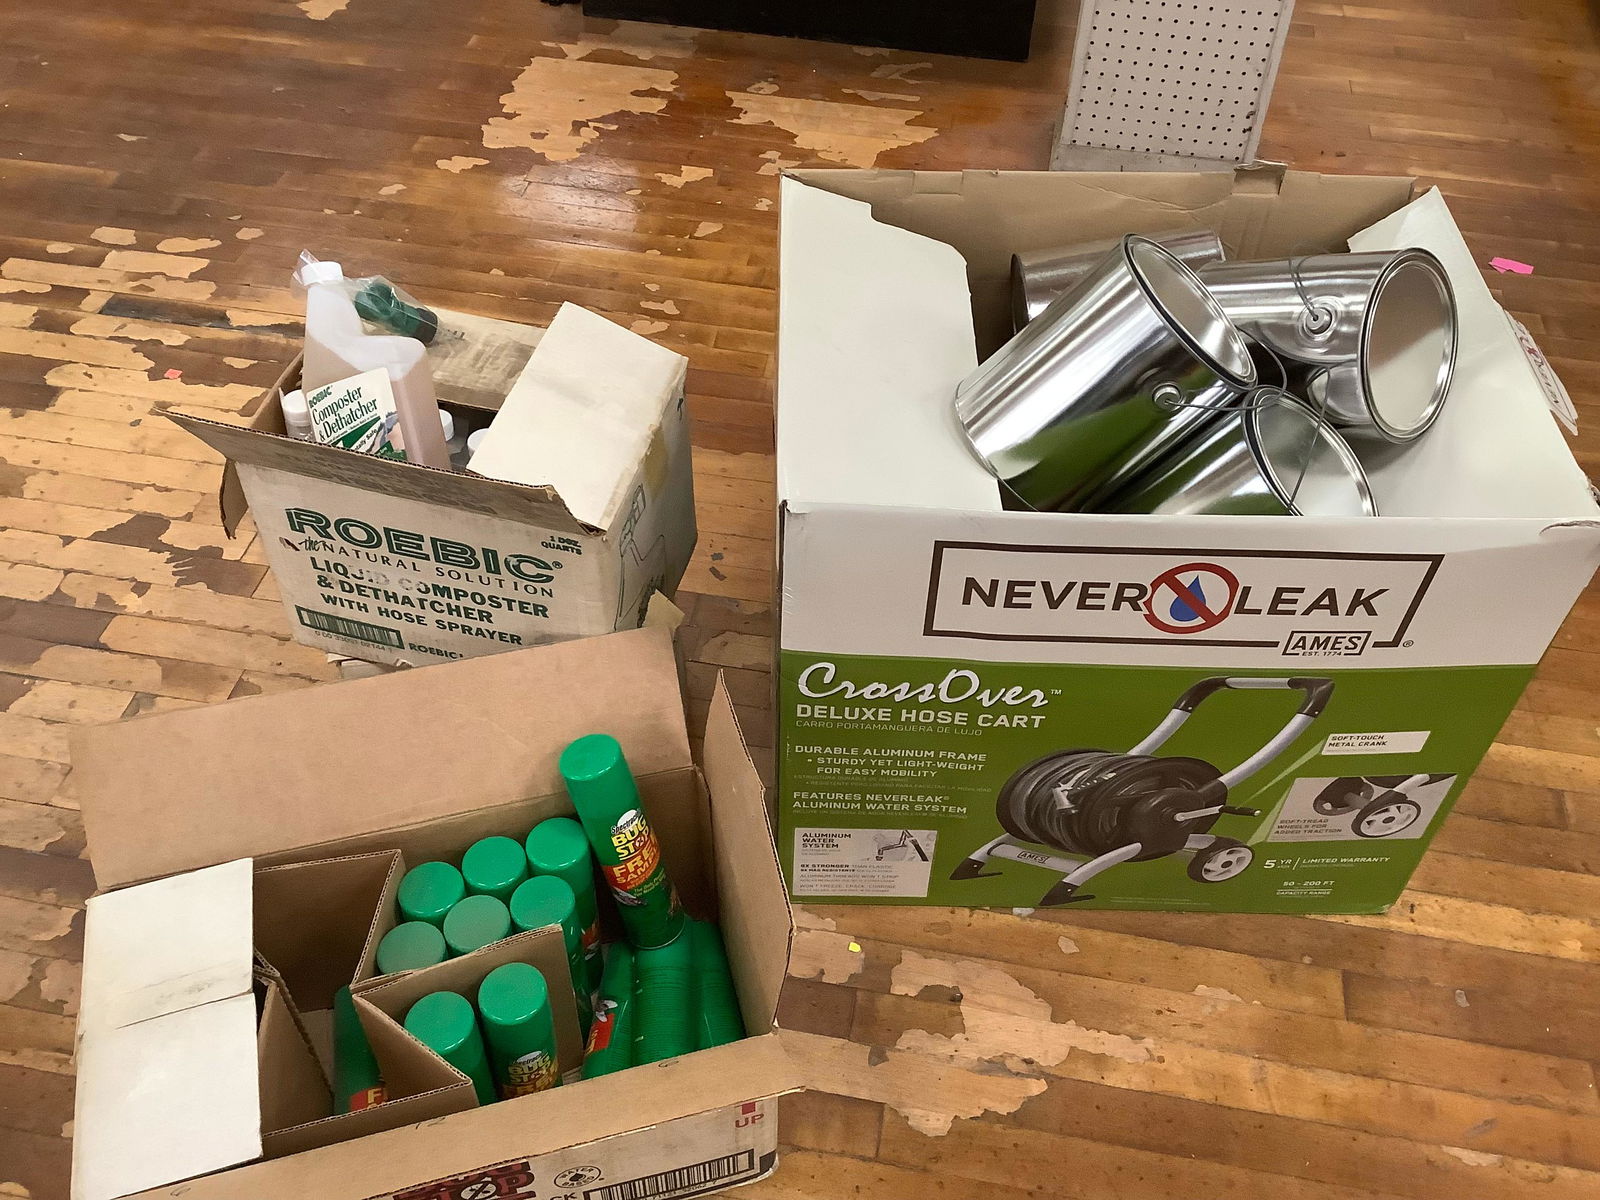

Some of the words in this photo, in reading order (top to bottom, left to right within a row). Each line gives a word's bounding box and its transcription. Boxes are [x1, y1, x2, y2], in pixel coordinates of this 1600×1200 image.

[312, 386, 363, 426] Composter
[319, 430, 325, 442] &
[323, 398, 378, 439] Dethatcher
[541, 541, 582, 555] QUARTS
[299, 535, 323, 552] the
[323, 543, 421, 572] NATURAL
[436, 567, 553, 598] SOLUTION
[317, 574, 334, 589] &
[339, 579, 494, 624] DETHATCHER
[399, 577, 549, 618] COMPOSTER
[962, 576, 1147, 612] NEVER
[1233, 584, 1390, 617] LEAK
[321, 592, 369, 614] WITH
[378, 606, 428, 626] HOSE
[435, 619, 522, 645] SPRAYER
[1291, 635, 1362, 650] AMES
[796, 703, 892, 721] DELUXE
[900, 708, 969, 726] HOSE
[977, 713, 1046, 729] CART
[796, 720, 833, 729] CARRO
[836, 722, 933, 733] PORTAMANGUERA
[937, 726, 951, 734] DE
[954, 728, 982, 736] LUJO
[795, 745, 859, 755] DURABLE
[863, 748, 934, 758] ALUMINUM
[939, 751, 987, 762] FRAME
[817, 757, 866, 766] STURDY
[870, 759, 893, 767] YET
[897, 760, 984, 771] LIGHT-WEIGHT
[845, 767, 876, 776] EASY
[881, 769, 938, 778] MOBILITY
[793, 791, 862, 800] FEATURES
[793, 801, 861, 810] ALUMINUM
[863, 802, 910, 811] WATER
[914, 804, 967, 814] SYSTEM
[611, 814, 646, 847] BUG
[1263, 859, 1277, 869] 5
[735, 1113, 764, 1128] UP
